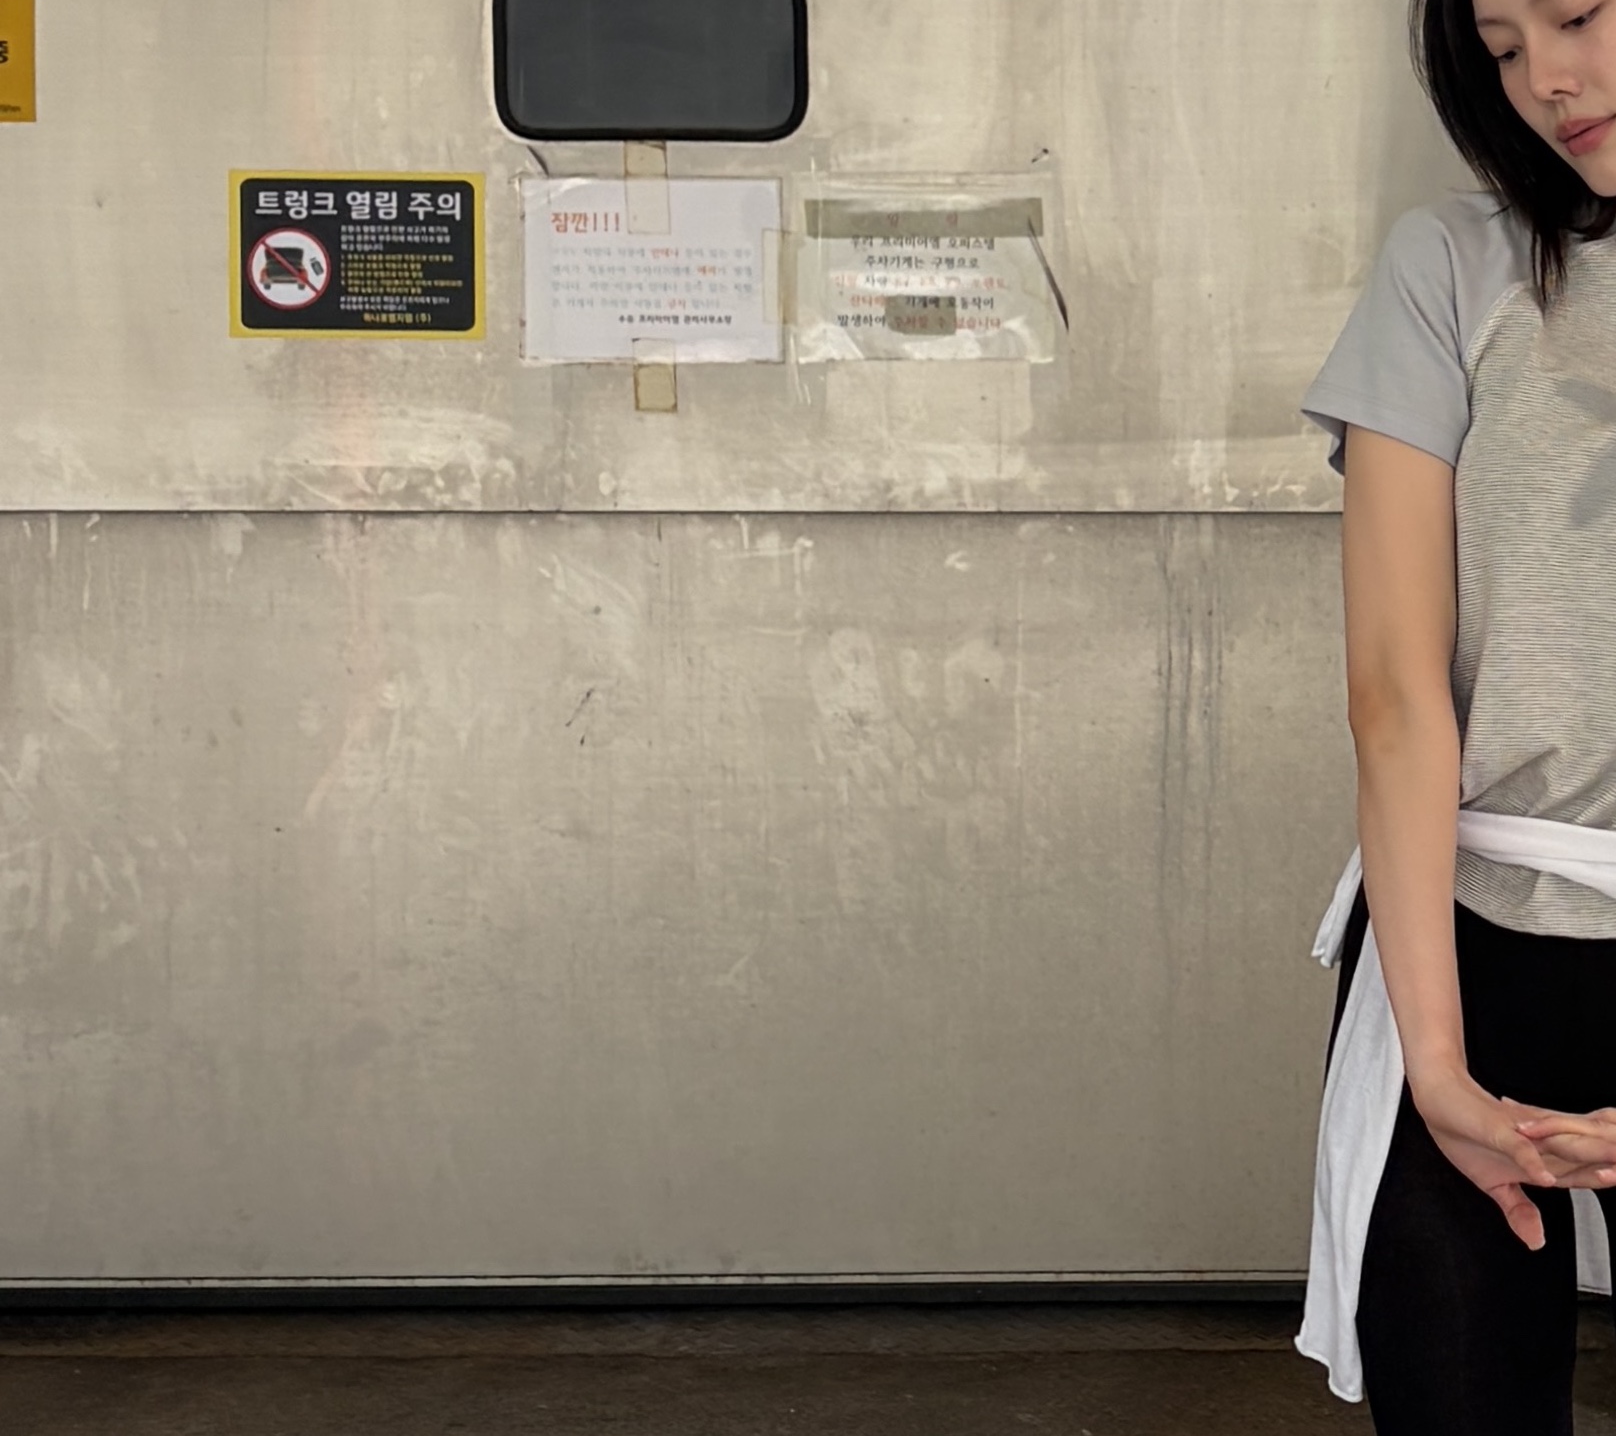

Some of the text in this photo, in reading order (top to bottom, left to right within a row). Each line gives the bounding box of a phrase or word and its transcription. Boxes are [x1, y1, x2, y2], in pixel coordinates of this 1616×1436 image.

[255, 190, 462, 221] 트렁크 열림 주의
[551, 212, 620, 233] 잠깐!!!
